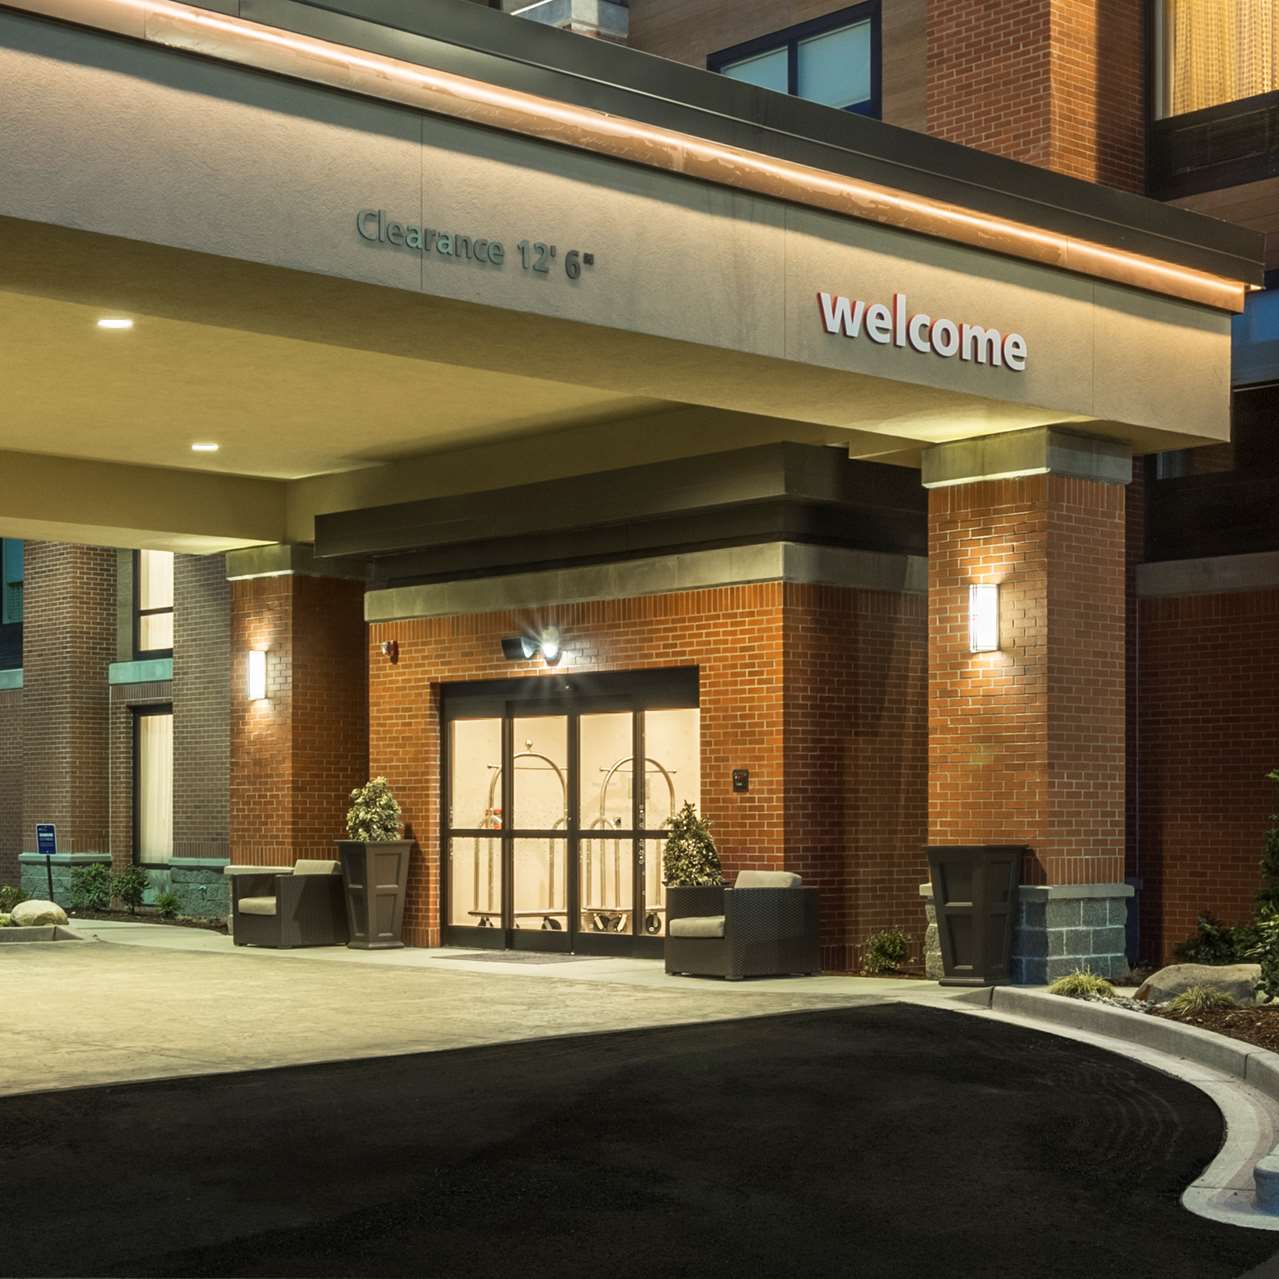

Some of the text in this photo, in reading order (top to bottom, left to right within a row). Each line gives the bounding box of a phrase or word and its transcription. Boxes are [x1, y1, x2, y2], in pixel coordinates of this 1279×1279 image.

[357, 209, 595, 280] Clearance 12' 6"
[818, 291, 1028, 371] welcome
